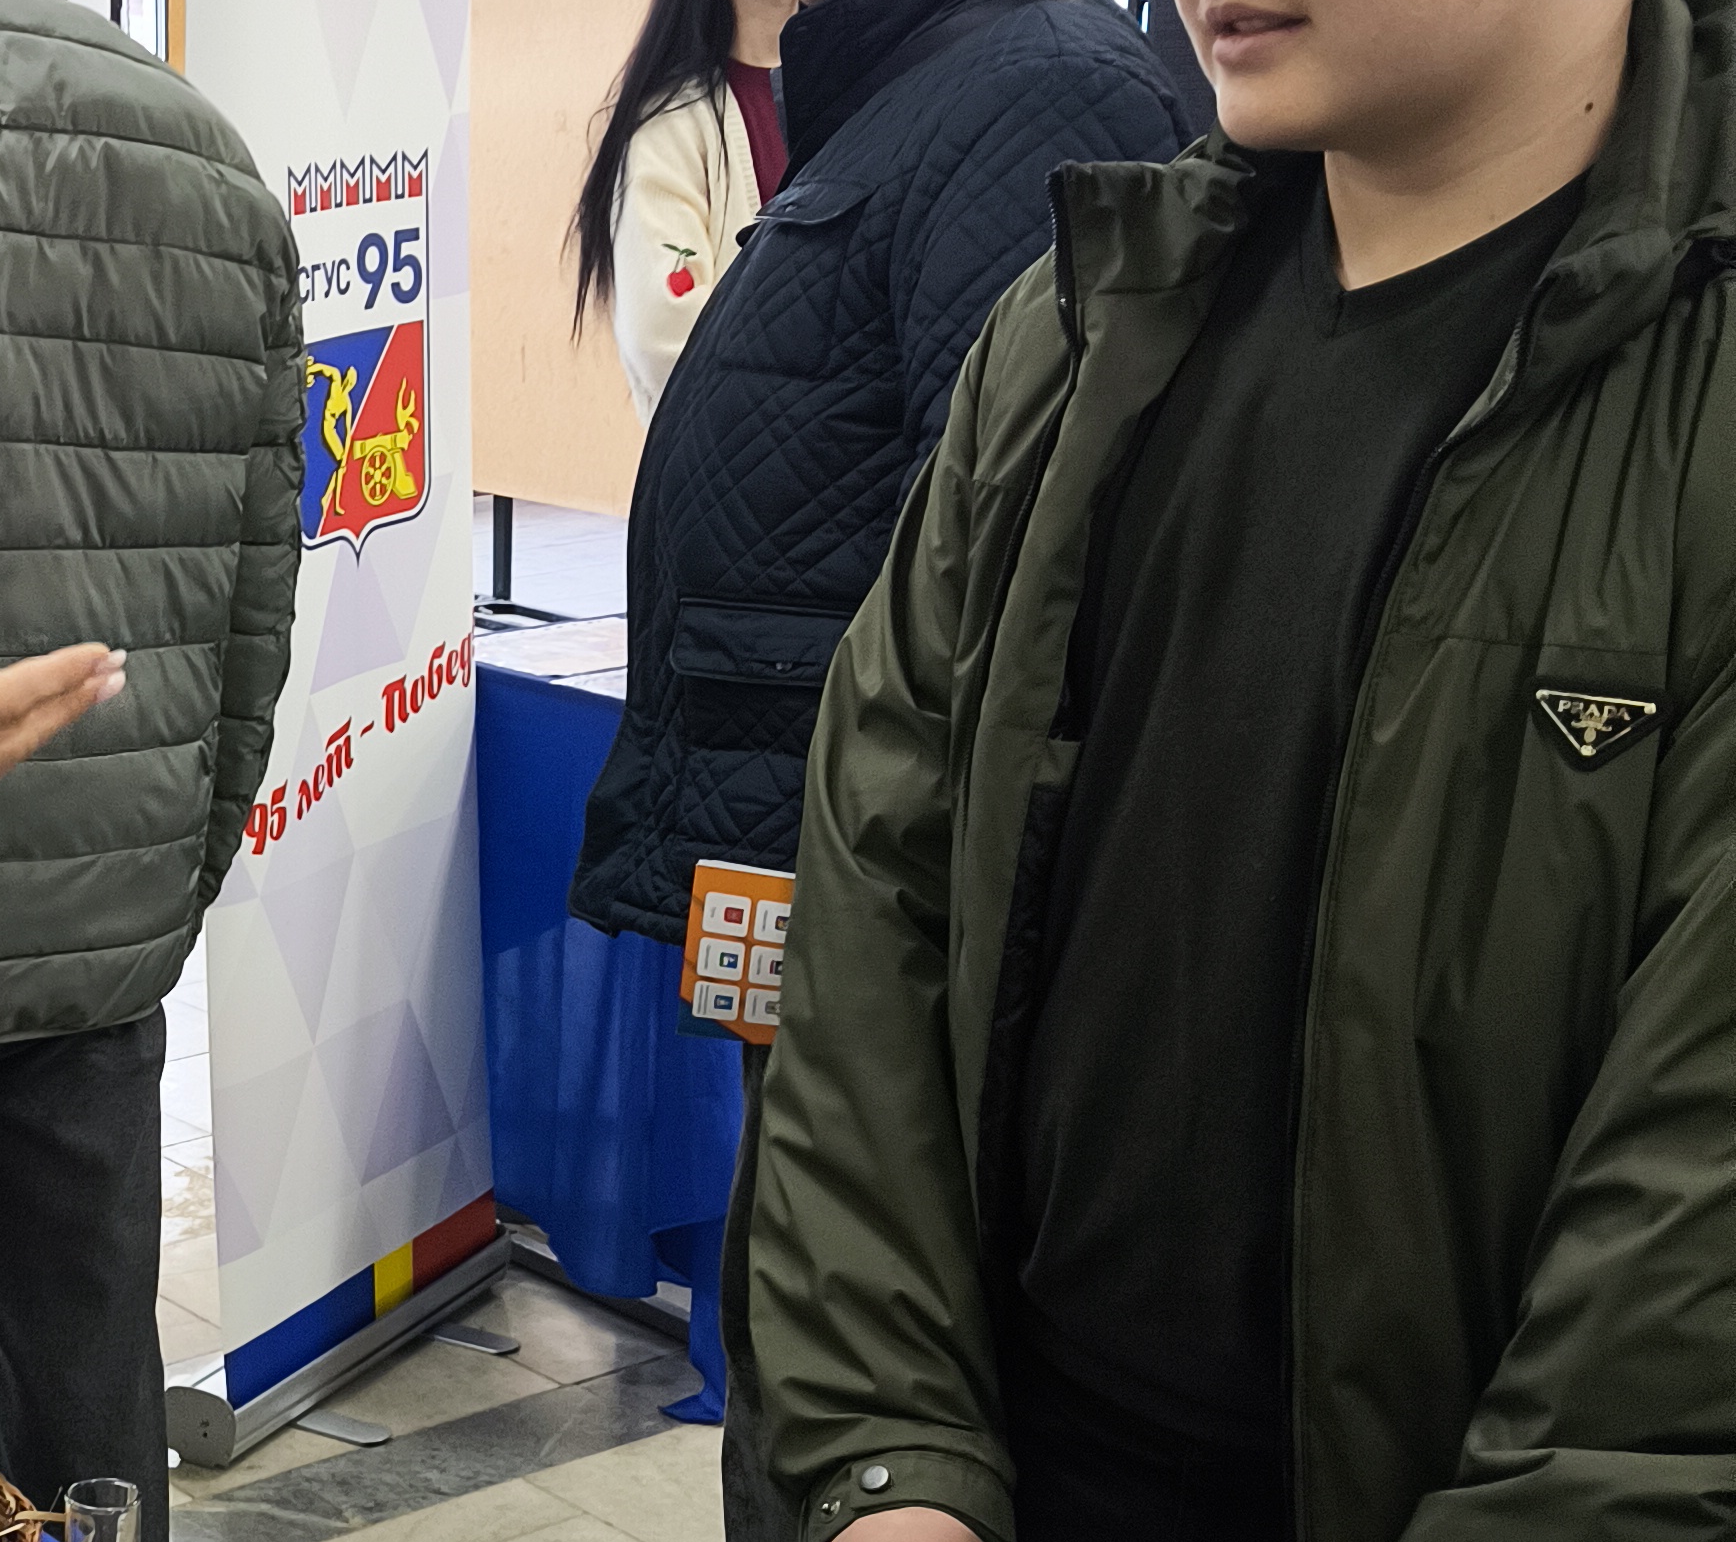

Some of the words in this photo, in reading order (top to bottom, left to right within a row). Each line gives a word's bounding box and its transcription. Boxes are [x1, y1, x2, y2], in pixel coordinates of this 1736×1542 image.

[297, 258, 351, 305] СГУС
[356, 226, 423, 310] 95
[243, 778, 288, 855] 95
[296, 716, 354, 820] лет
[381, 631, 474, 733] Побед
[1557, 699, 1631, 721] PRADA
